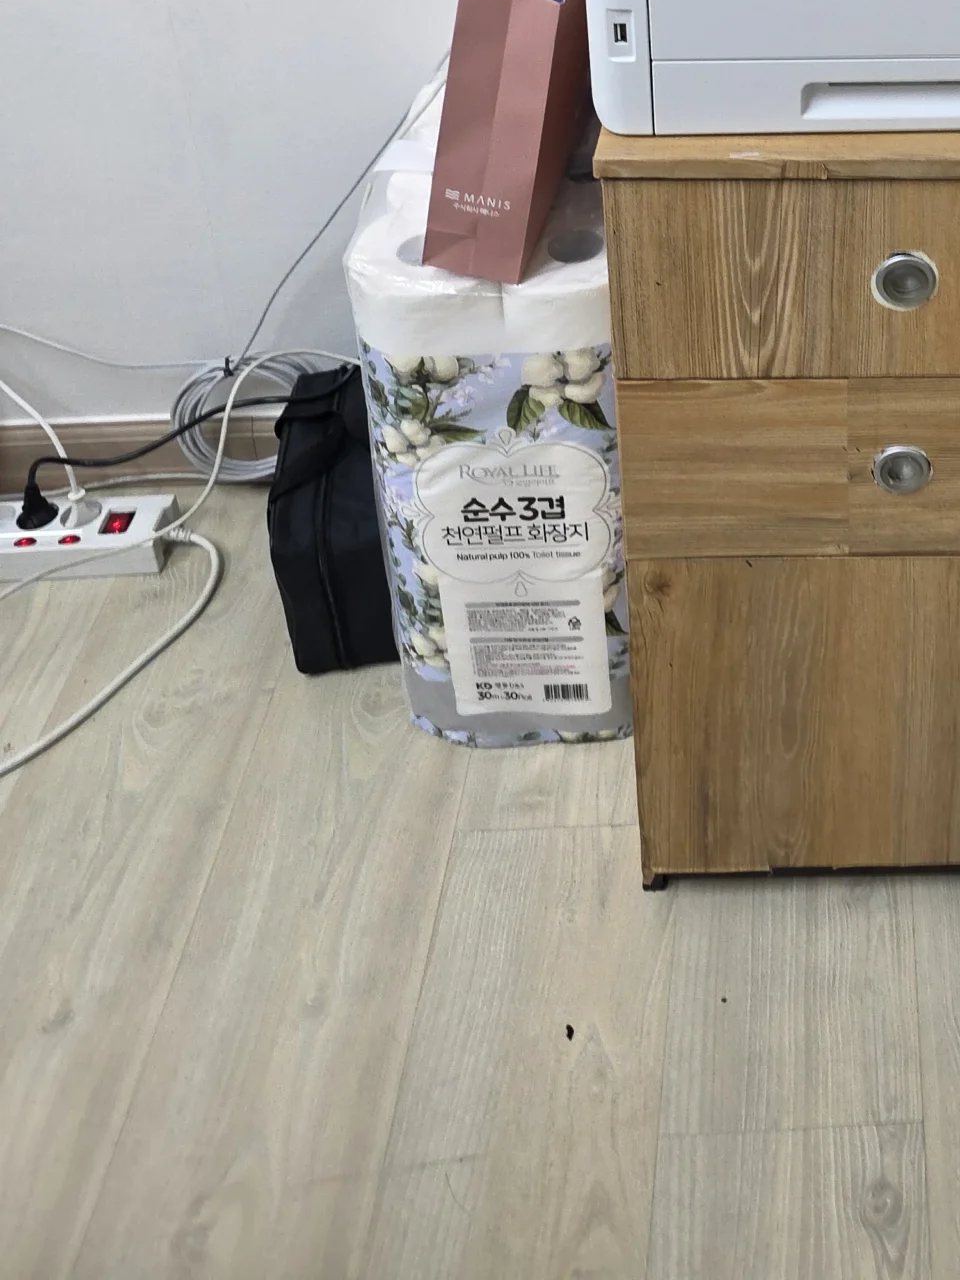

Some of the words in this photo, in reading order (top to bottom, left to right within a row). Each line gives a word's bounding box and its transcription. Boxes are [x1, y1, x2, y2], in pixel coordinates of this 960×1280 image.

[464, 193, 511, 211] MANIS
[459, 464, 517, 480] ROYAL
[520, 464, 560, 478] LIFE
[441, 524, 525, 546] 천연펄프
[527, 521, 589, 543] 화장지
[456, 552, 488, 561] Natural
[489, 552, 508, 562] pulp
